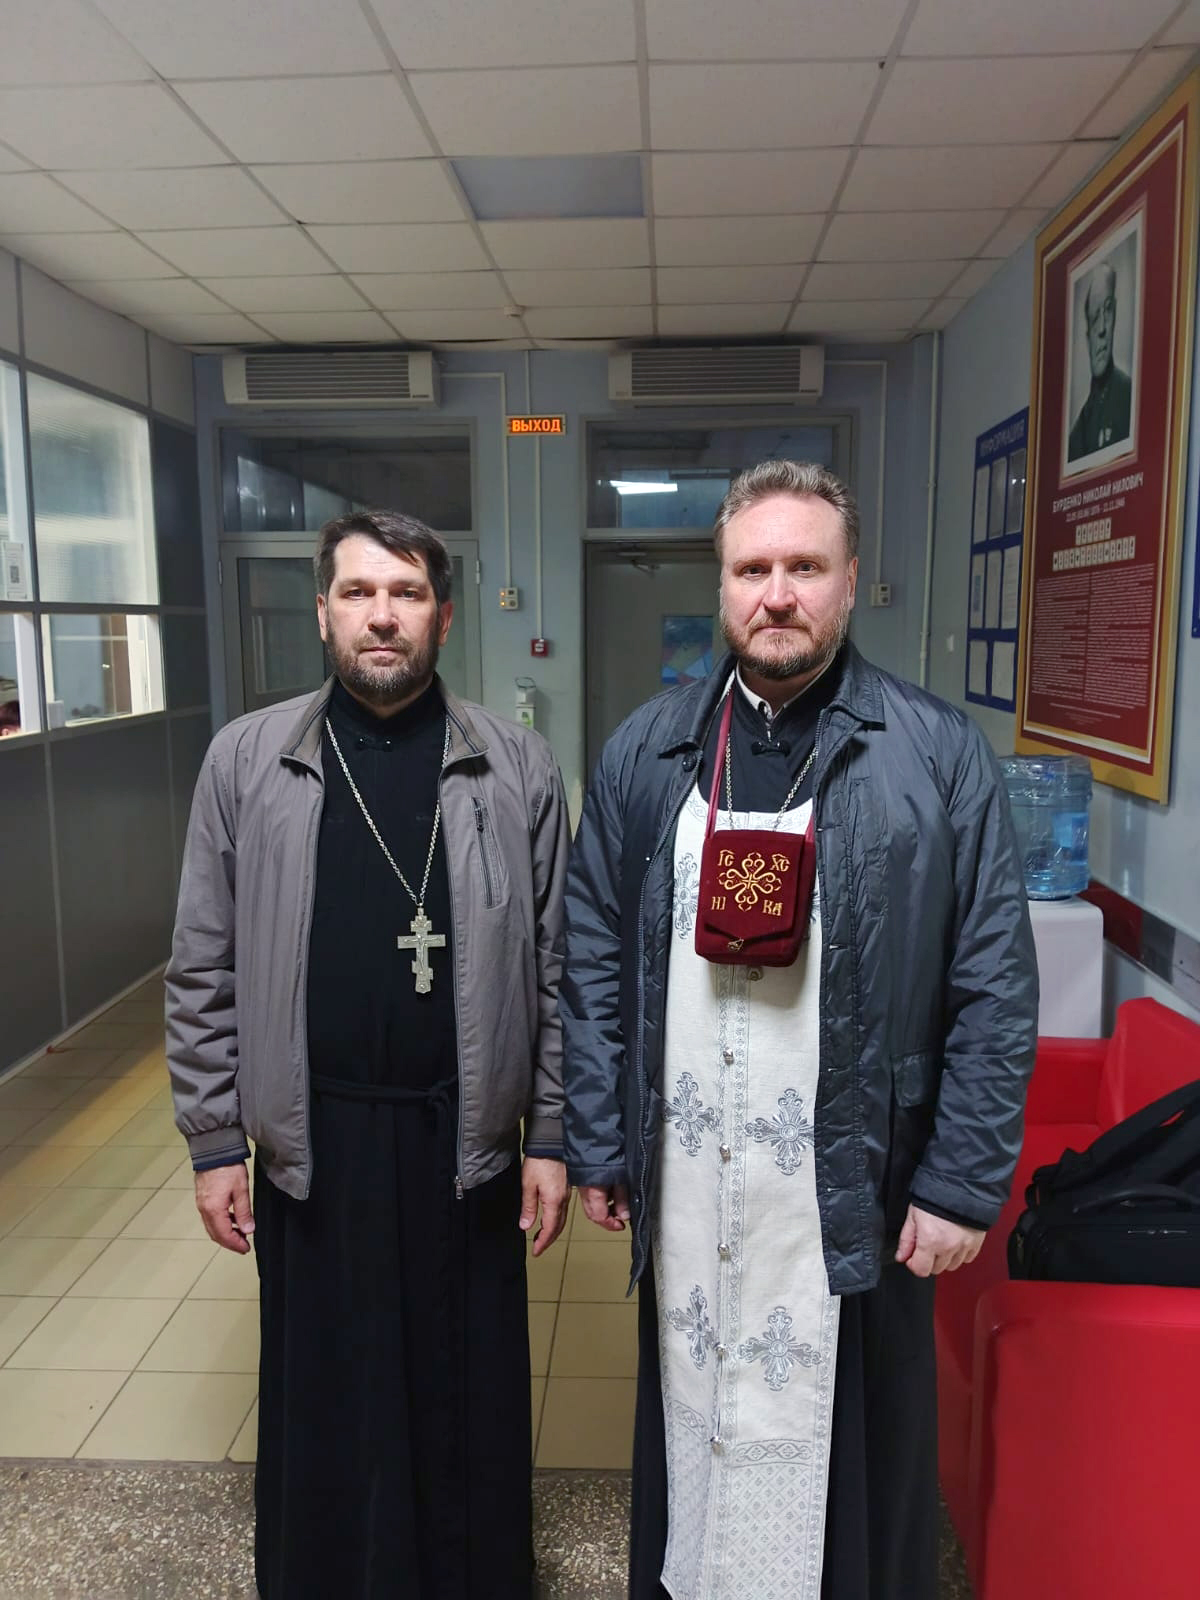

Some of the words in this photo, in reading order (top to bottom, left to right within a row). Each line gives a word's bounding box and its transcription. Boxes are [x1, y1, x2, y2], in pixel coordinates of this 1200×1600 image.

[511, 418, 562, 433] ВЫХОД
[1052, 492, 1082, 514] БУРДЕНКО
[1082, 480, 1112, 505] НИКОЛАЙ
[1112, 471, 1144, 495] НИЛОВИЧ
